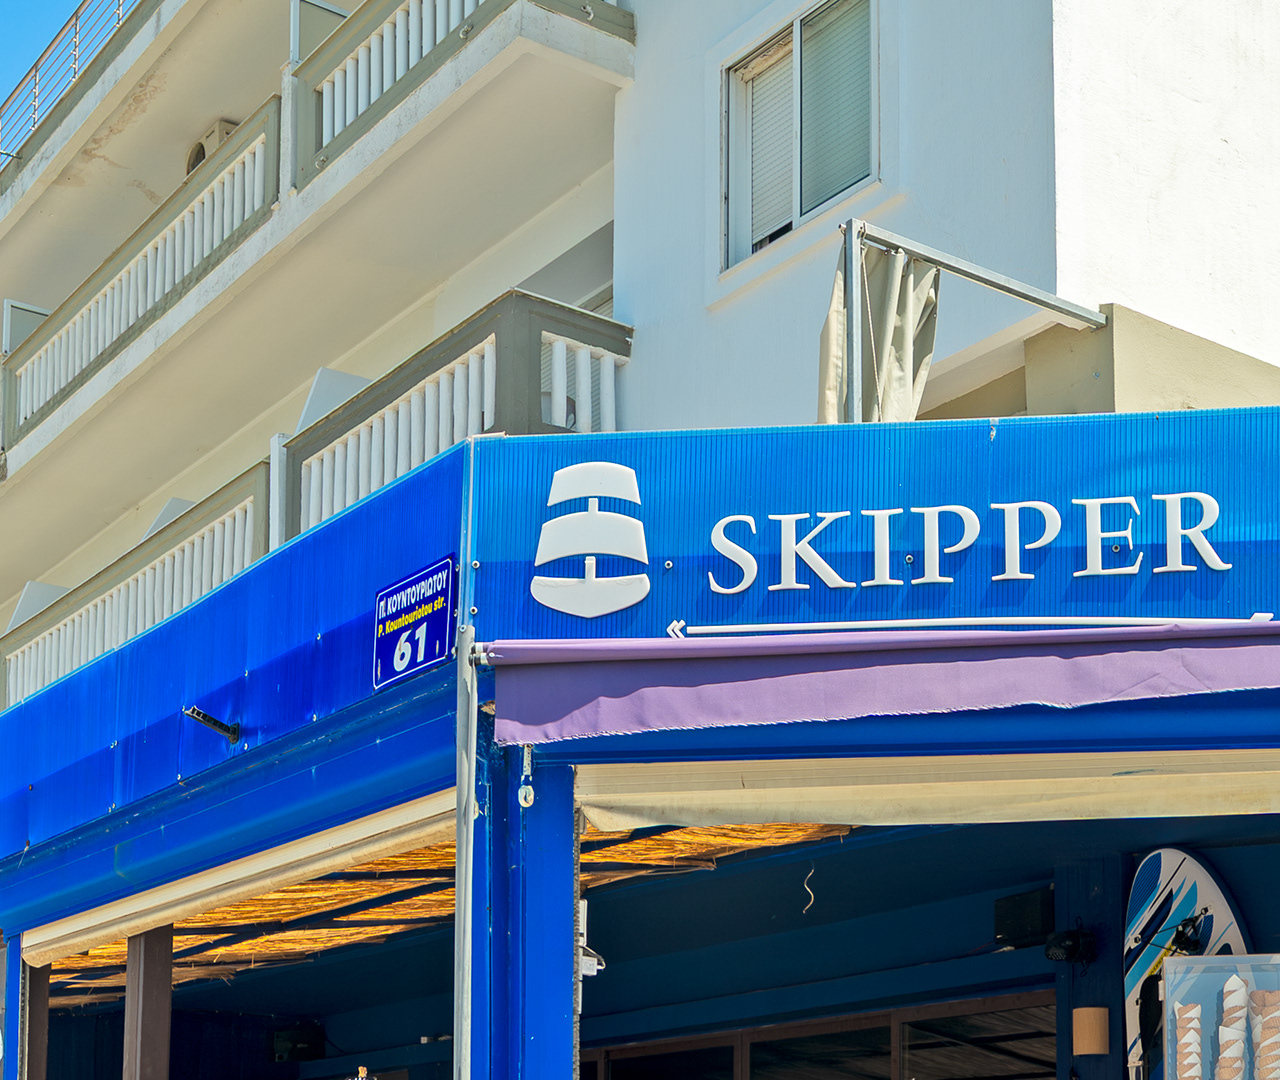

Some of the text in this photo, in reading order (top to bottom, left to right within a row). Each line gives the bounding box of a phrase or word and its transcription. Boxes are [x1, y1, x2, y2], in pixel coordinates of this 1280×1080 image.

[708, 491, 1233, 595] SKIPPER
[378, 596, 447, 637] P. Kountouriotou str.
[387, 569, 448, 616] ΚΟΥΝΤΟΥΡΙΩΤΟΥ
[393, 622, 427, 672] 61
